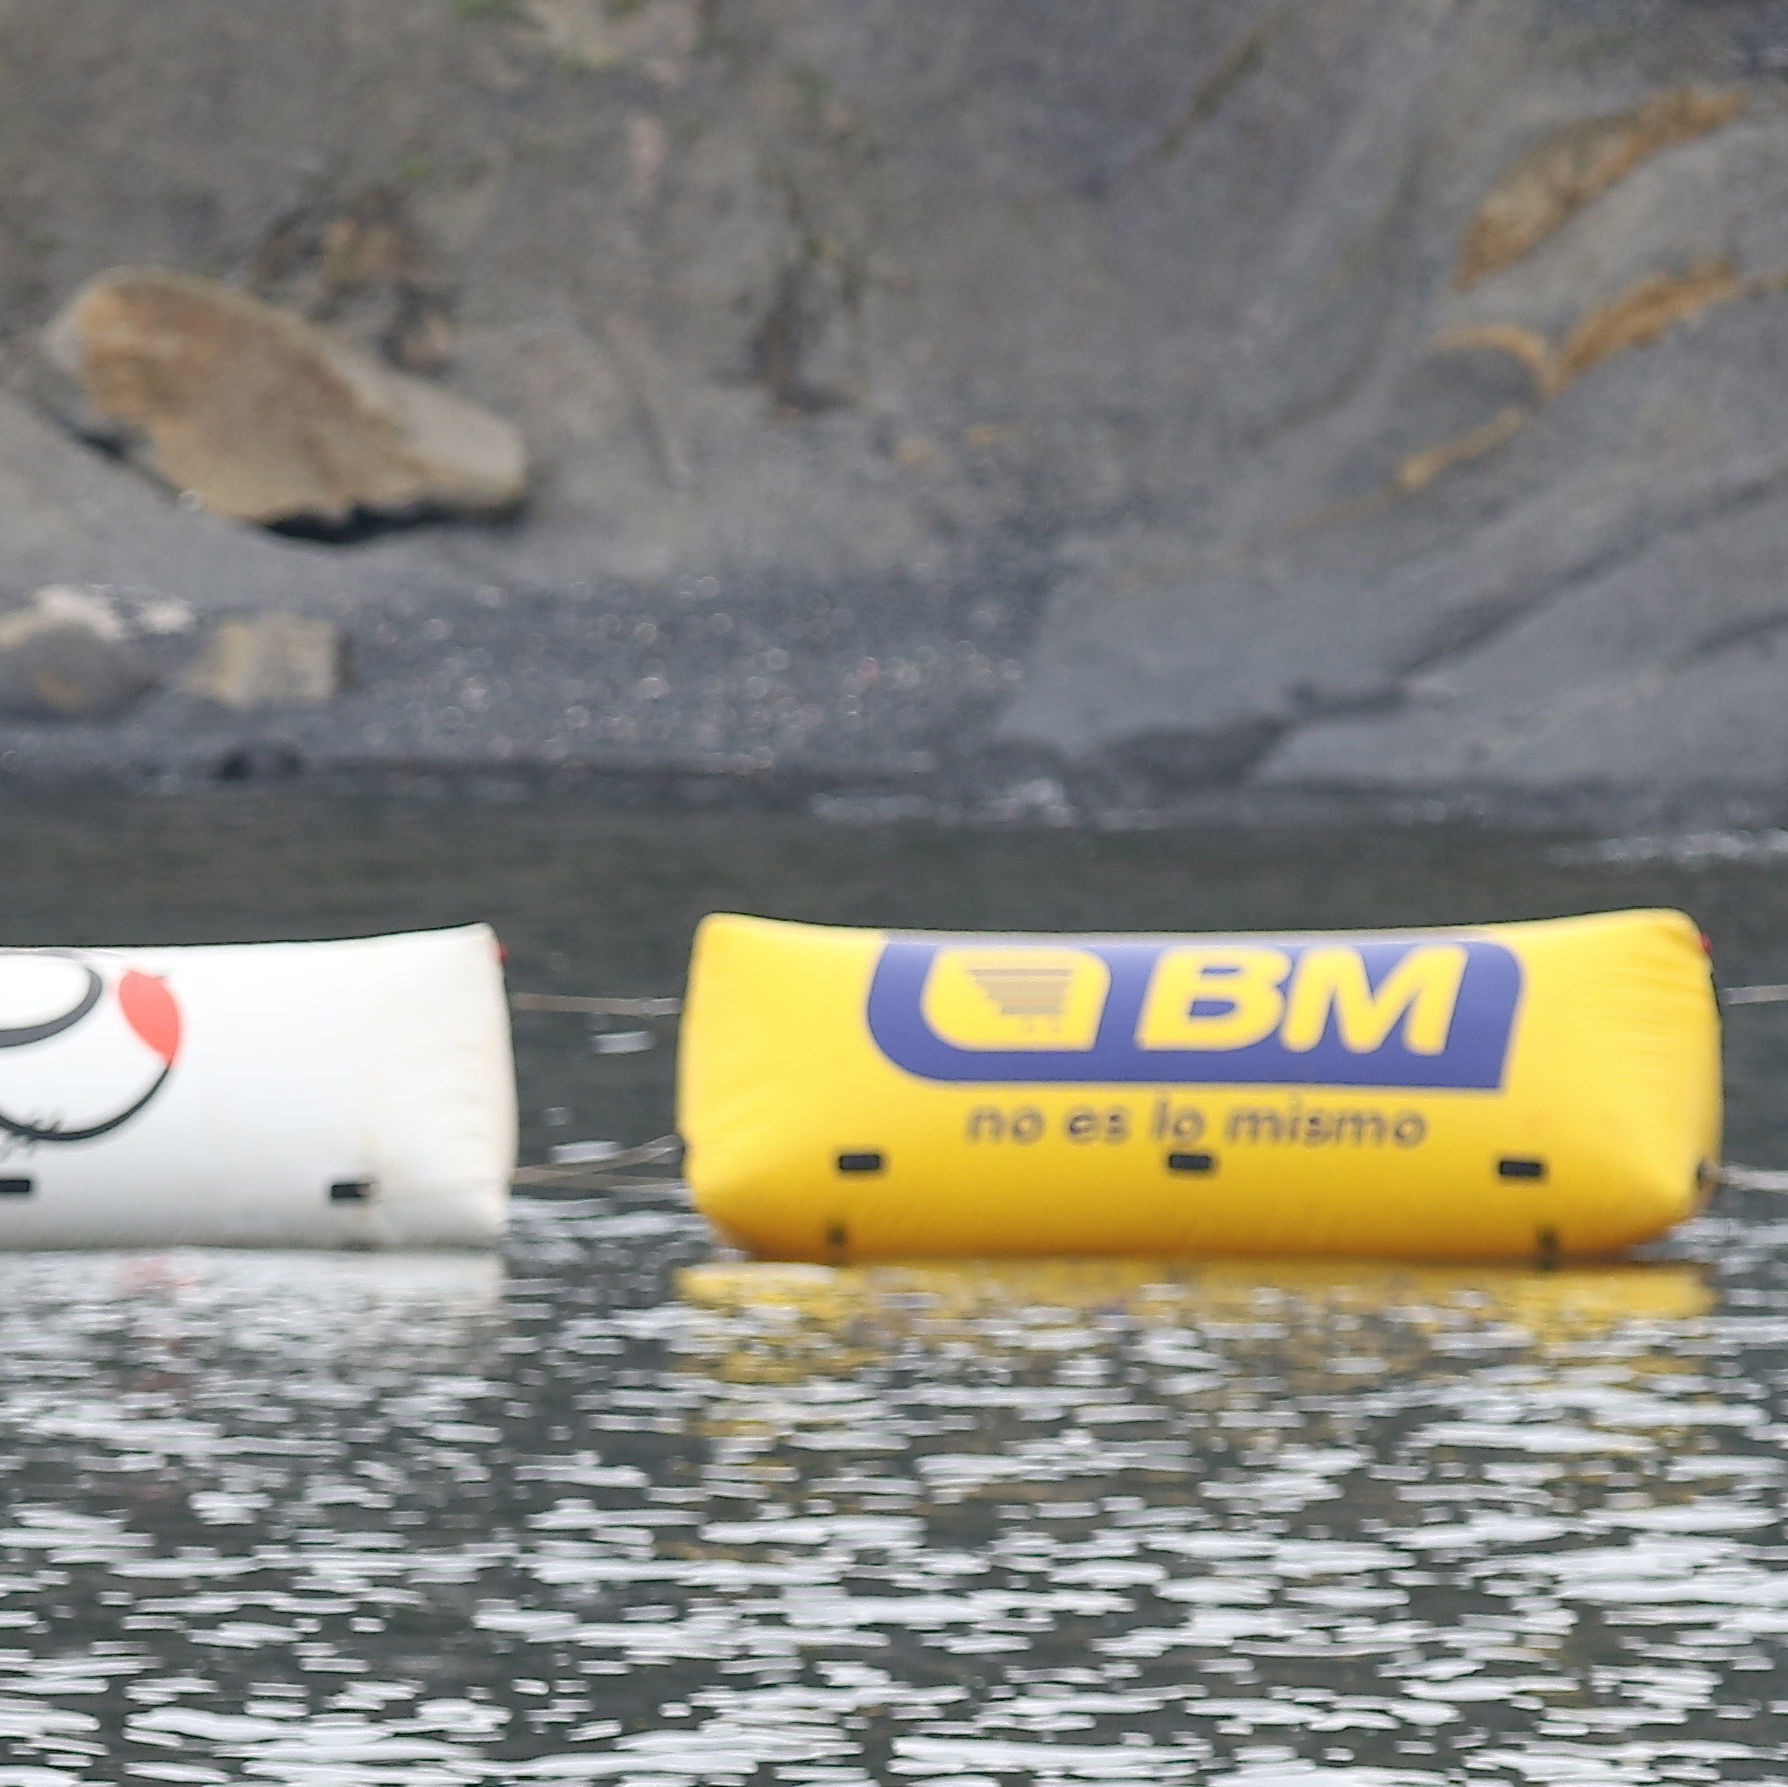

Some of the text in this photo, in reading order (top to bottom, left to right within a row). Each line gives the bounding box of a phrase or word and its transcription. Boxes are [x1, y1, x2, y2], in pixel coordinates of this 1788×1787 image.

[1134, 947, 1470, 1054] BM
[968, 1096, 1425, 1146] no es lo mismo
